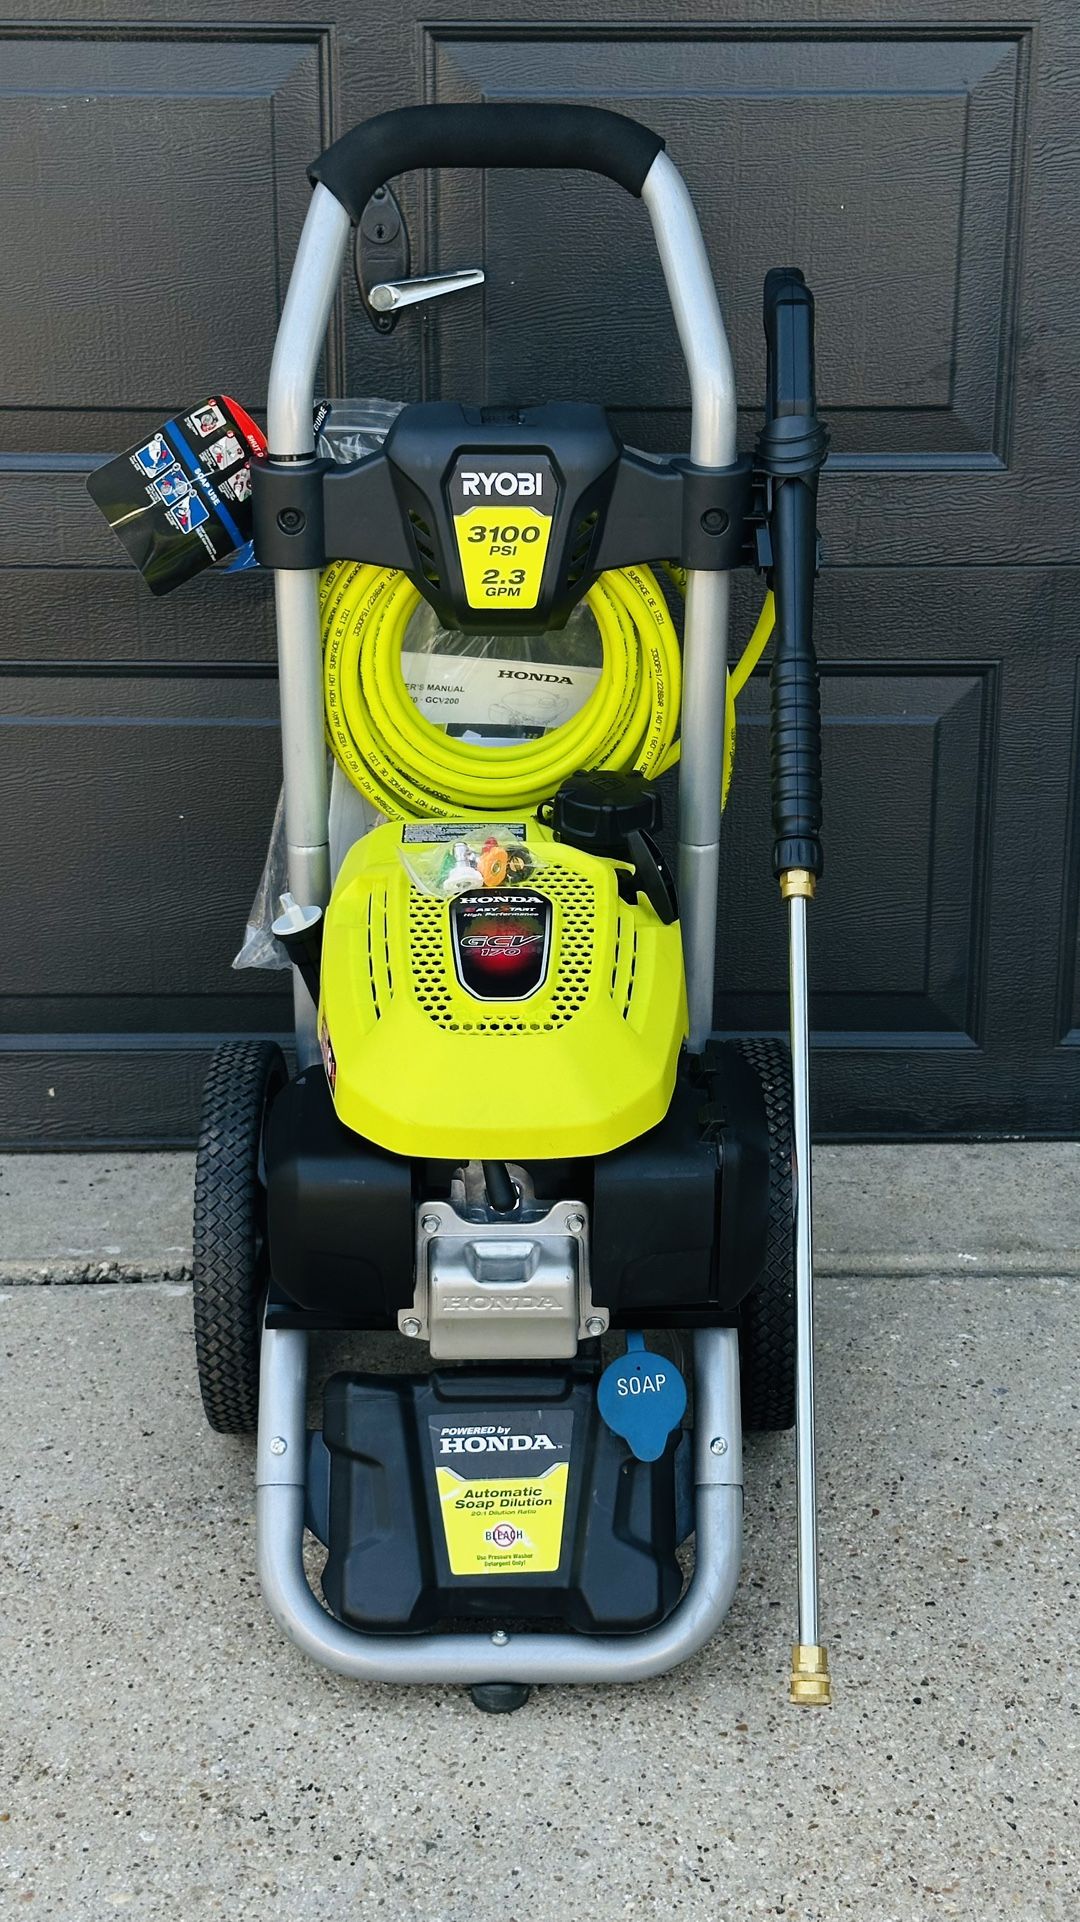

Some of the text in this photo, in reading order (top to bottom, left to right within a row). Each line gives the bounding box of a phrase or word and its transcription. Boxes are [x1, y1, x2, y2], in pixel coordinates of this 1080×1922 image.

[313, 406, 328, 431] GUIDE
[246, 434, 262, 452] SHUT
[461, 472, 542, 496] RYOBI
[208, 488, 220, 506] USE
[468, 526, 540, 543] 3100
[490, 546, 517, 556] PSI
[326, 570, 336, 587] KEEP
[481, 570, 525, 584] 2.3
[486, 588, 520, 596] GPM
[627, 570, 651, 596] SURFACE
[653, 609, 665, 626] 1321
[329, 640, 340, 670] SURFACE
[498, 670, 573, 685] HONDA
[426, 684, 465, 693] MANUAL
[332, 710, 341, 728] AWAY
[337, 731, 348, 748] KEEP
[388, 777, 414, 799] SURFACE
[415, 799, 428, 808] HOT
[460, 896, 544, 904] HONDA
[460, 934, 544, 948] GCV
[481, 948, 520, 956] 170
[443, 1296, 563, 1311] HONDA
[617, 1374, 666, 1396] SOAP
[441, 1426, 511, 1436] POWERED by
[440, 1434, 557, 1454] HONDA
[464, 1487, 542, 1498] Automatic
[455, 1498, 552, 1510] Soap Dilution
[486, 1530, 523, 1540] BLEACH
